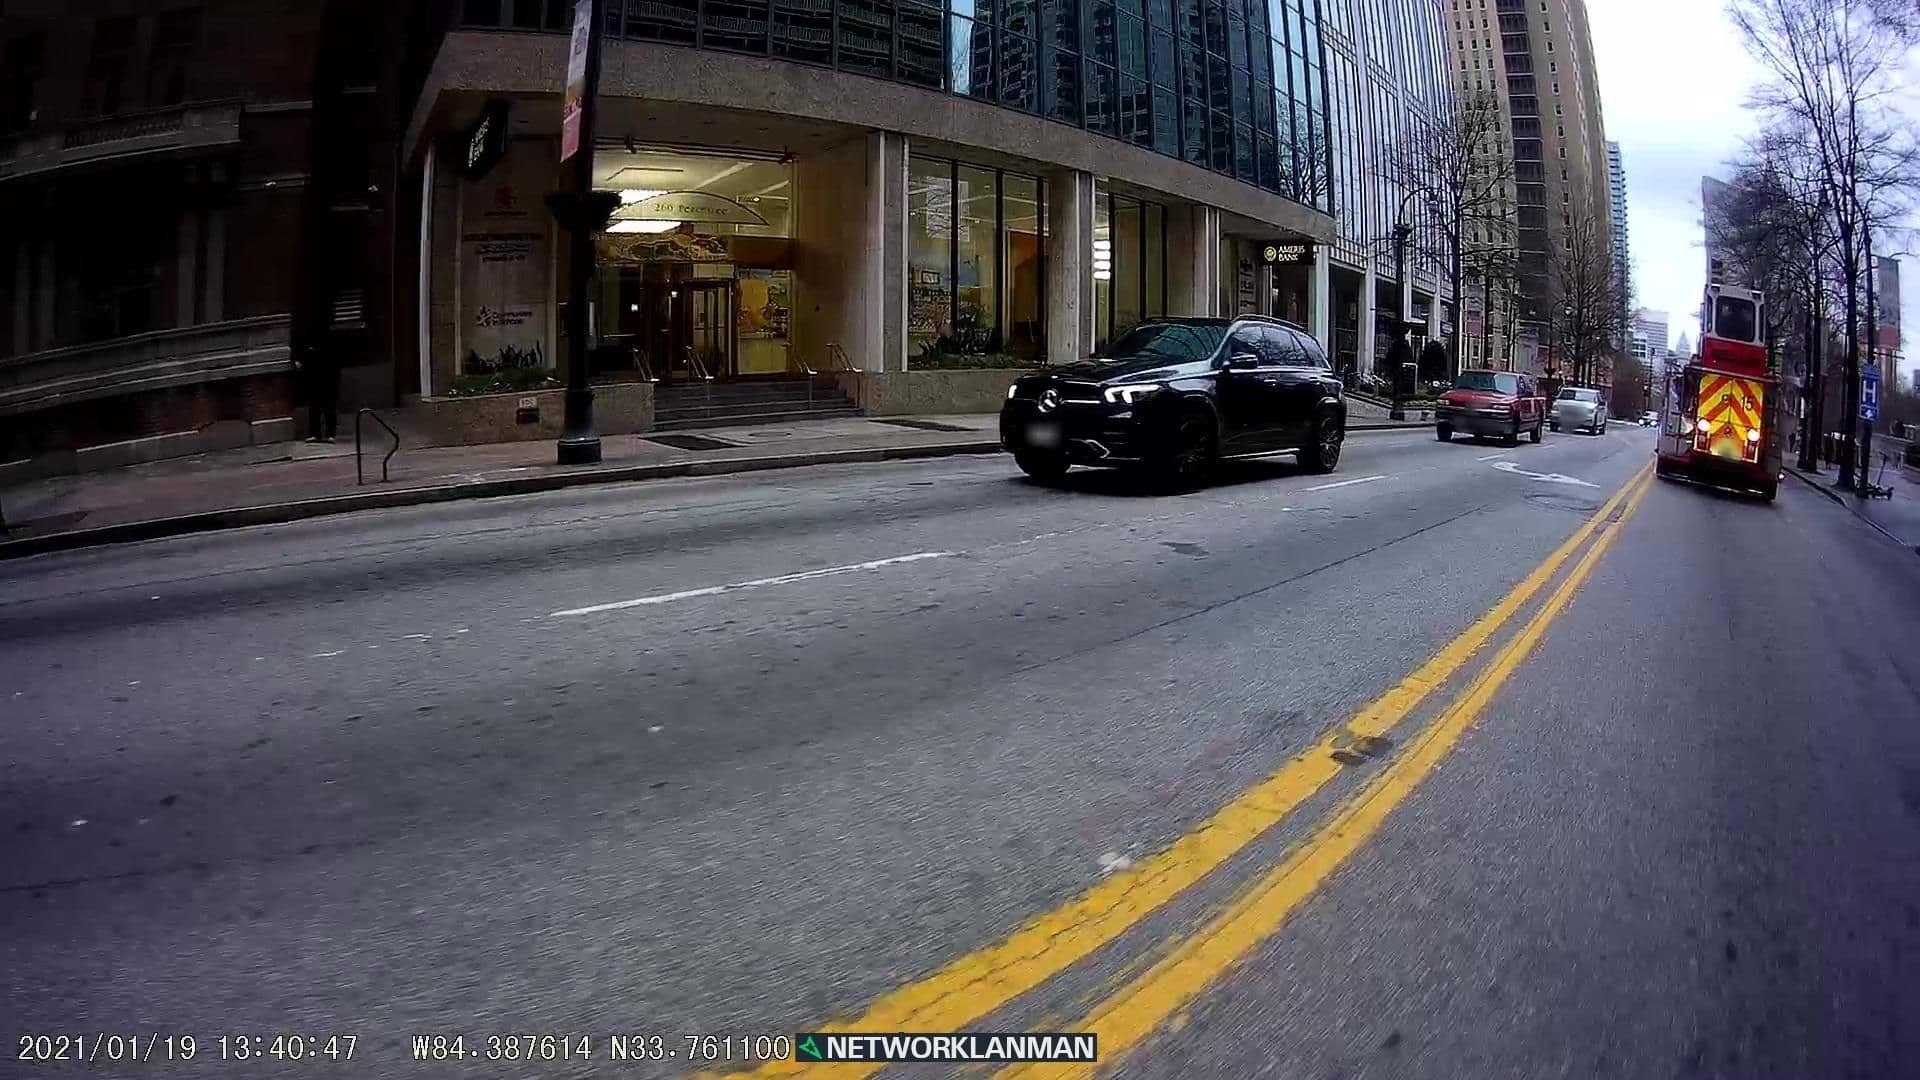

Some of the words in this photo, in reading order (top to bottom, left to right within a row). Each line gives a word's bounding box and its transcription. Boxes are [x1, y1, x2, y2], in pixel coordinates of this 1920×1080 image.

[655, 203, 673, 212] 260
[1278, 253, 1298, 262] BANK
[1862, 380, 1876, 404] H
